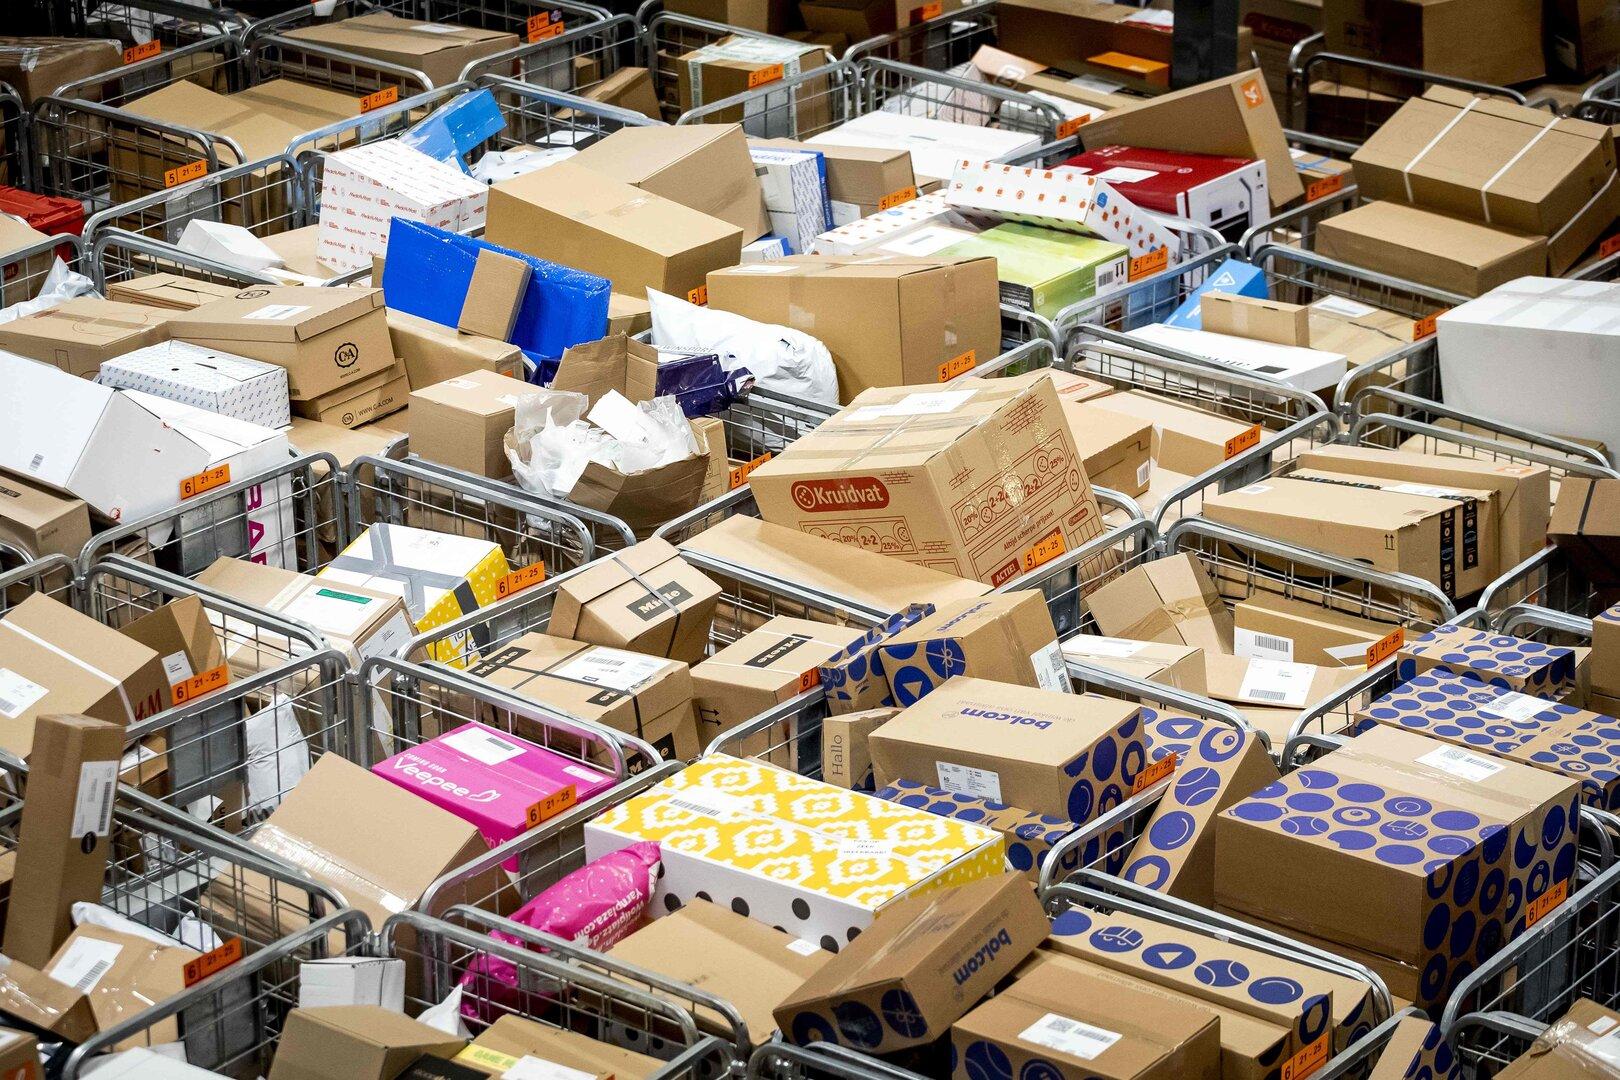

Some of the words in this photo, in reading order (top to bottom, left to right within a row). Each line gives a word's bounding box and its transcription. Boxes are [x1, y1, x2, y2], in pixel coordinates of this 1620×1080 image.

[363, 99, 368, 109] 5
[169, 173, 175, 183] 5
[691, 293, 697, 304] 5
[1416, 324, 1422, 336] 5
[338, 347, 355, 363] C&A
[953, 362, 960, 370] 21
[964, 355, 971, 363] 25
[941, 367, 947, 379] 5
[1228, 442, 1233, 454] 5
[200, 474, 209, 484] 21
[215, 469, 224, 479] 25
[734, 472, 740, 484] 5
[184, 482, 191, 493] 6
[814, 484, 884, 504] Kruidvat
[1003, 539, 1017, 551] Altijd
[1039, 548, 1046, 556] 21
[1051, 541, 1059, 550] 25
[1026, 554, 1033, 566] 5
[514, 573, 523, 583] 21
[529, 567, 538, 578] 25
[499, 581, 506, 594] 6
[1381, 642, 1388, 650] 21
[1392, 634, 1400, 643] 25
[1369, 649, 1375, 662] 5
[194, 677, 203, 688] 21
[210, 671, 220, 682] 25
[802, 674, 809, 687] 6
[176, 686, 184, 700] 6
[961, 706, 1054, 730] bol.com
[832, 734, 843, 776] Hallo
[1151, 766, 1159, 776] 21
[1164, 758, 1172, 769] 25
[394, 756, 470, 797] Veepee
[1136, 776, 1143, 788] 6
[546, 799, 555, 810] 21
[561, 789, 570, 801] 25
[530, 809, 537, 822] 6
[1542, 896, 1550, 907] 21
[1554, 887, 1562, 899] 25
[574, 888, 643, 940] Yarnplaza.com
[1528, 909, 1535, 921] 6
[953, 927, 1012, 985] bol.com
[188, 965, 196, 979] 6
[1299, 1054, 1307, 1064] 21
[1313, 1042, 1322, 1054] 25
[1284, 1066, 1291, 1079] 6
